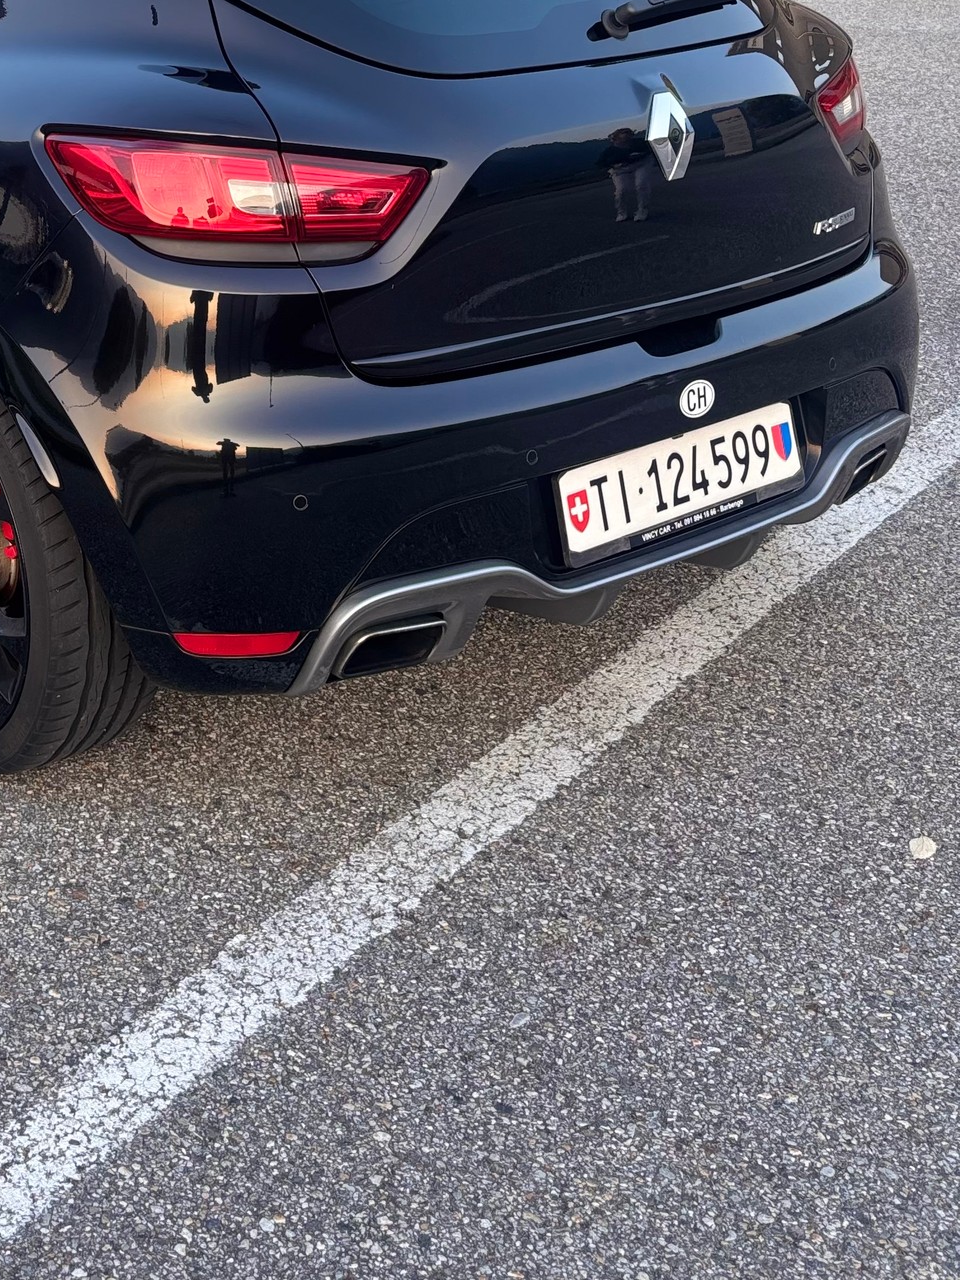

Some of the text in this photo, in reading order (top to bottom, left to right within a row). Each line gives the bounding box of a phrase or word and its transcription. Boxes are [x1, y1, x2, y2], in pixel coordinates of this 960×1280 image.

[686, 385, 708, 412] CH
[658, 524, 672, 535] CAR
[719, 499, 744, 513] Barbengo
